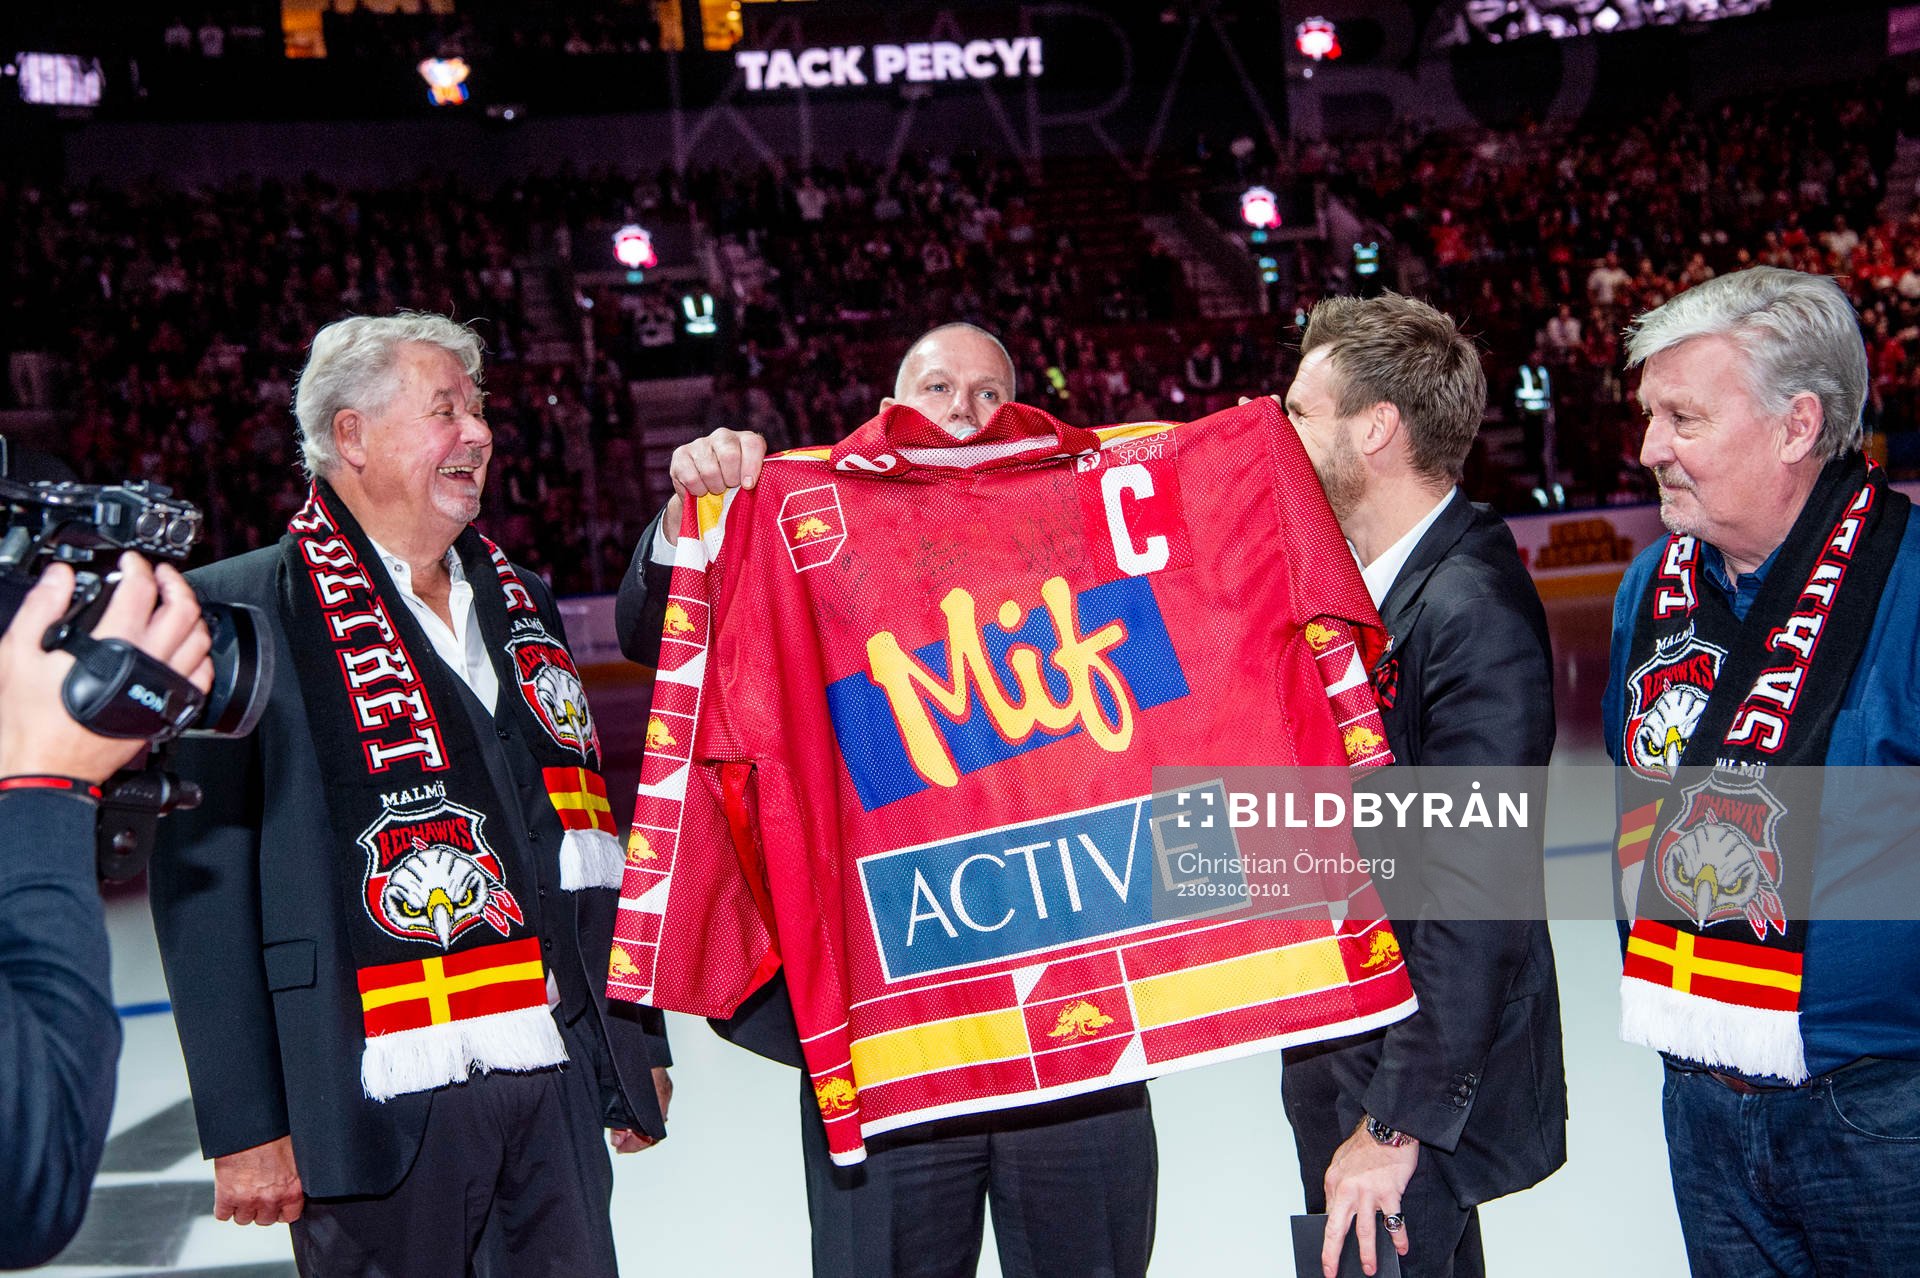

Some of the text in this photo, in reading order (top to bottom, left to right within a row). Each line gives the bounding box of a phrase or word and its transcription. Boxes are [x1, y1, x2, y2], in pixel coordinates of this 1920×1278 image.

[736, 36, 1044, 90] TACK PERCY!
[1119, 443, 1164, 466] SPORT
[1101, 463, 1170, 577] C
[127, 683, 164, 712] SON
[866, 576, 1133, 787] Mif
[380, 780, 447, 808] MALMÖ
[377, 816, 475, 867] REDHAWKS
[905, 800, 1210, 947] ACTIVE
